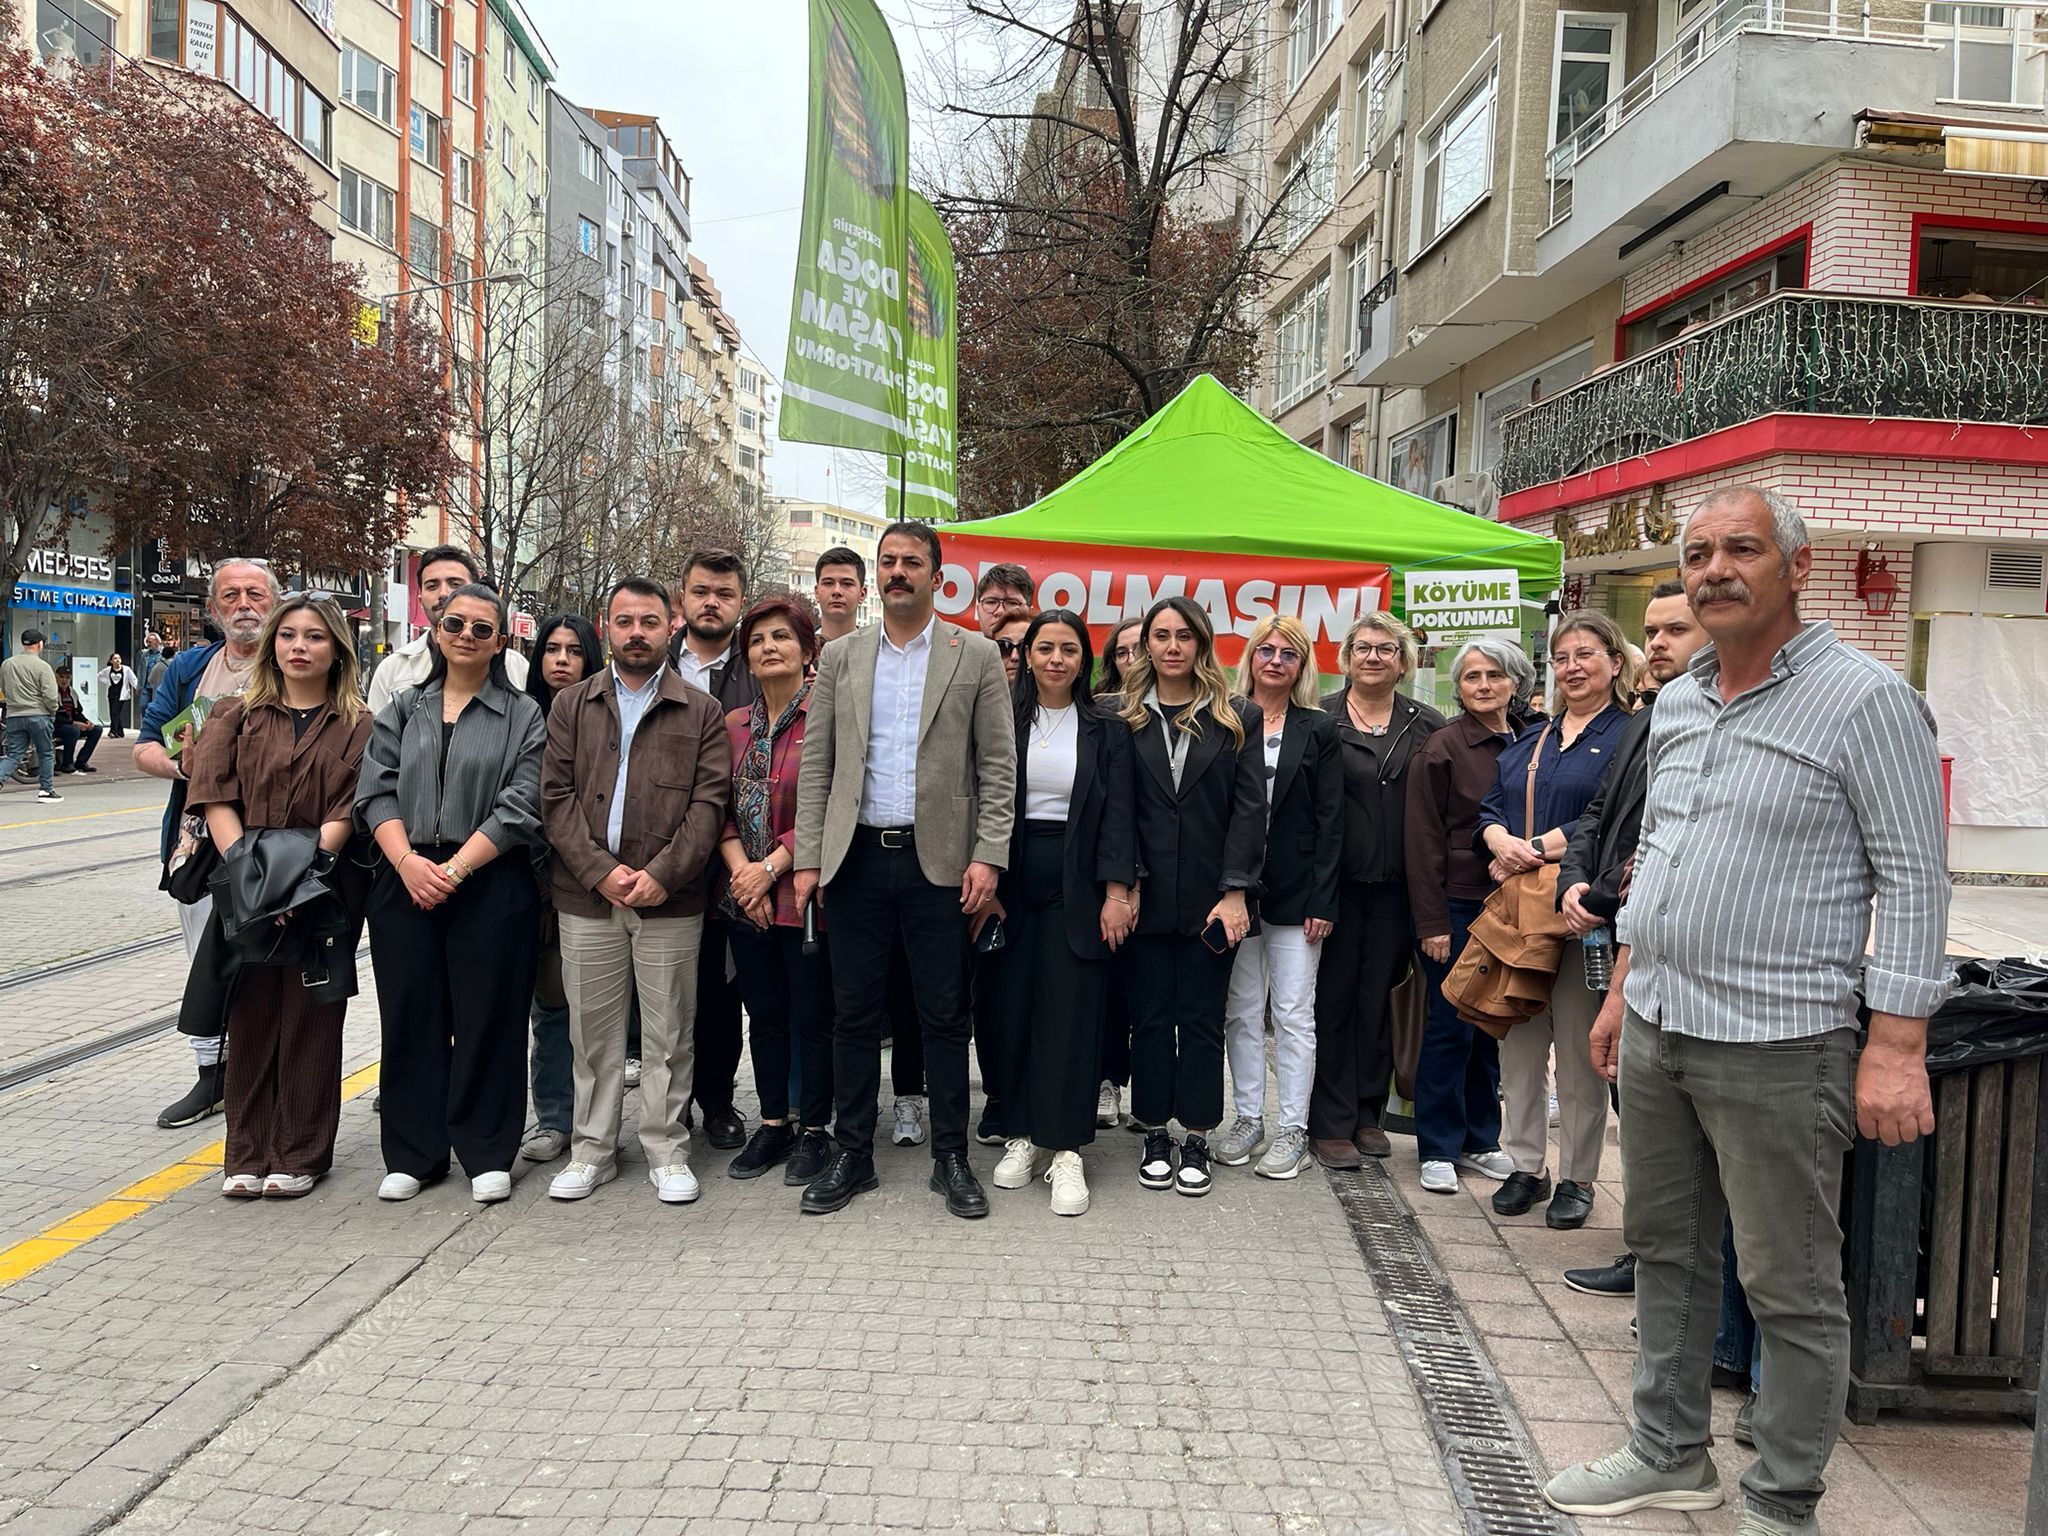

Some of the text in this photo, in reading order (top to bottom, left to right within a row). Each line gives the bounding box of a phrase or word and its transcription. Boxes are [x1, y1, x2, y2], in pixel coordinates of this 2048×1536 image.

[190, 19, 214, 31] PROTEZ
[190, 28, 214, 40] TIRNAK
[190, 39, 214, 51] KALICI
[194, 50, 208, 60] OJE
[23, 548, 112, 581] MEDISES
[14, 587, 59, 603] ŞITME
[1413, 580, 1512, 605] KÖYÜME
[1412, 609, 1514, 628] DOKUNMA!
[520, 623, 529, 634] E
